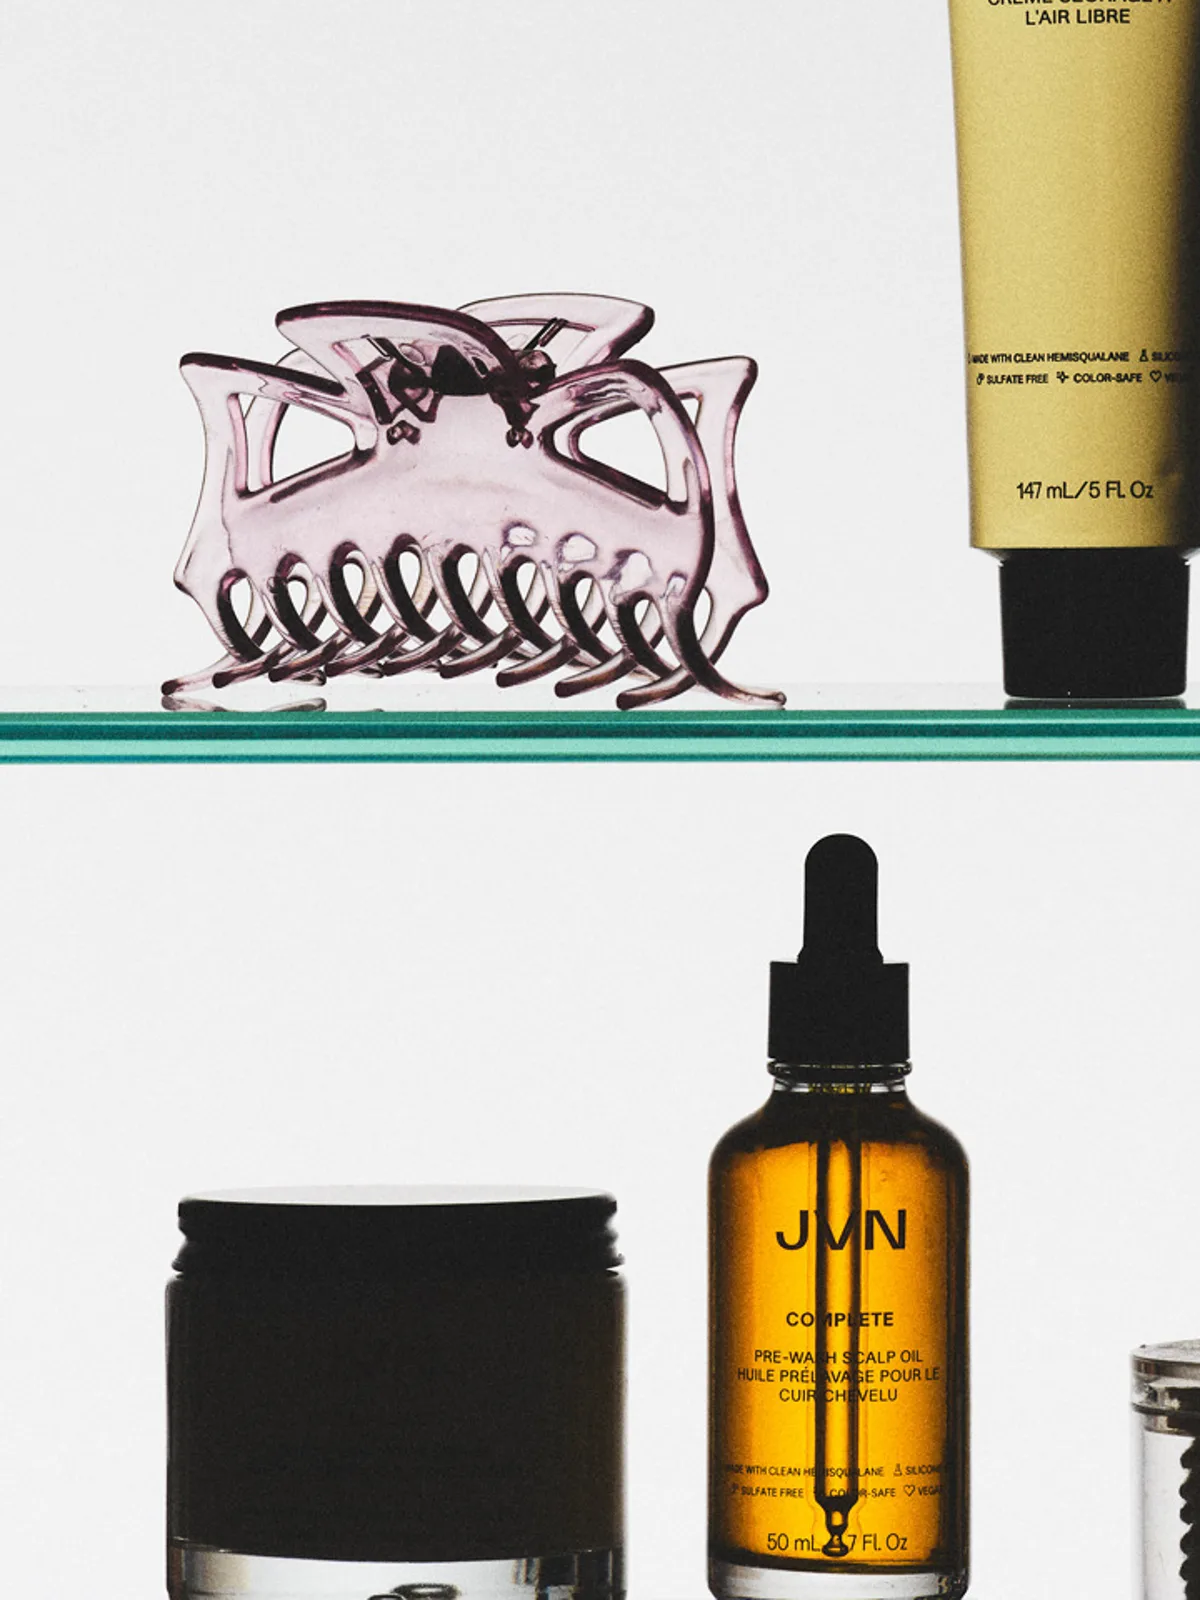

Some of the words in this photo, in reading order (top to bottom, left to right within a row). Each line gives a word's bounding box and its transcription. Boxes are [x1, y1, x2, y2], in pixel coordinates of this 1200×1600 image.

[1025, 9, 1070, 26] L'AIR
[1076, 9, 1131, 25] LIBRE
[991, 353, 1012, 364] WITH
[1014, 352, 1045, 363] CLEAN
[1047, 351, 1129, 364] HEMISQUALANE
[986, 374, 1024, 384] SULFATE
[1026, 373, 1049, 384] FREE
[1073, 372, 1142, 383] COLOR-SAFE
[1016, 482, 1042, 499] 147
[1130, 480, 1154, 498] Oz
[776, 1209, 906, 1250] JVN
[754, 1350, 837, 1364] PRE-WAH
[843, 1350, 895, 1364] SCALP
[901, 1349, 923, 1363] OIL
[737, 1368, 774, 1382] HUILE
[880, 1368, 921, 1382] POUR
[925, 1367, 940, 1381] LE
[780, 1388, 816, 1402] CUIR
[746, 1464, 767, 1475] WITH
[768, 1466, 800, 1476] CLEAN
[741, 1486, 777, 1497] SULFATE
[780, 1488, 804, 1498] FREE
[767, 1532, 789, 1551] 50
[886, 1532, 908, 1551] Oz
